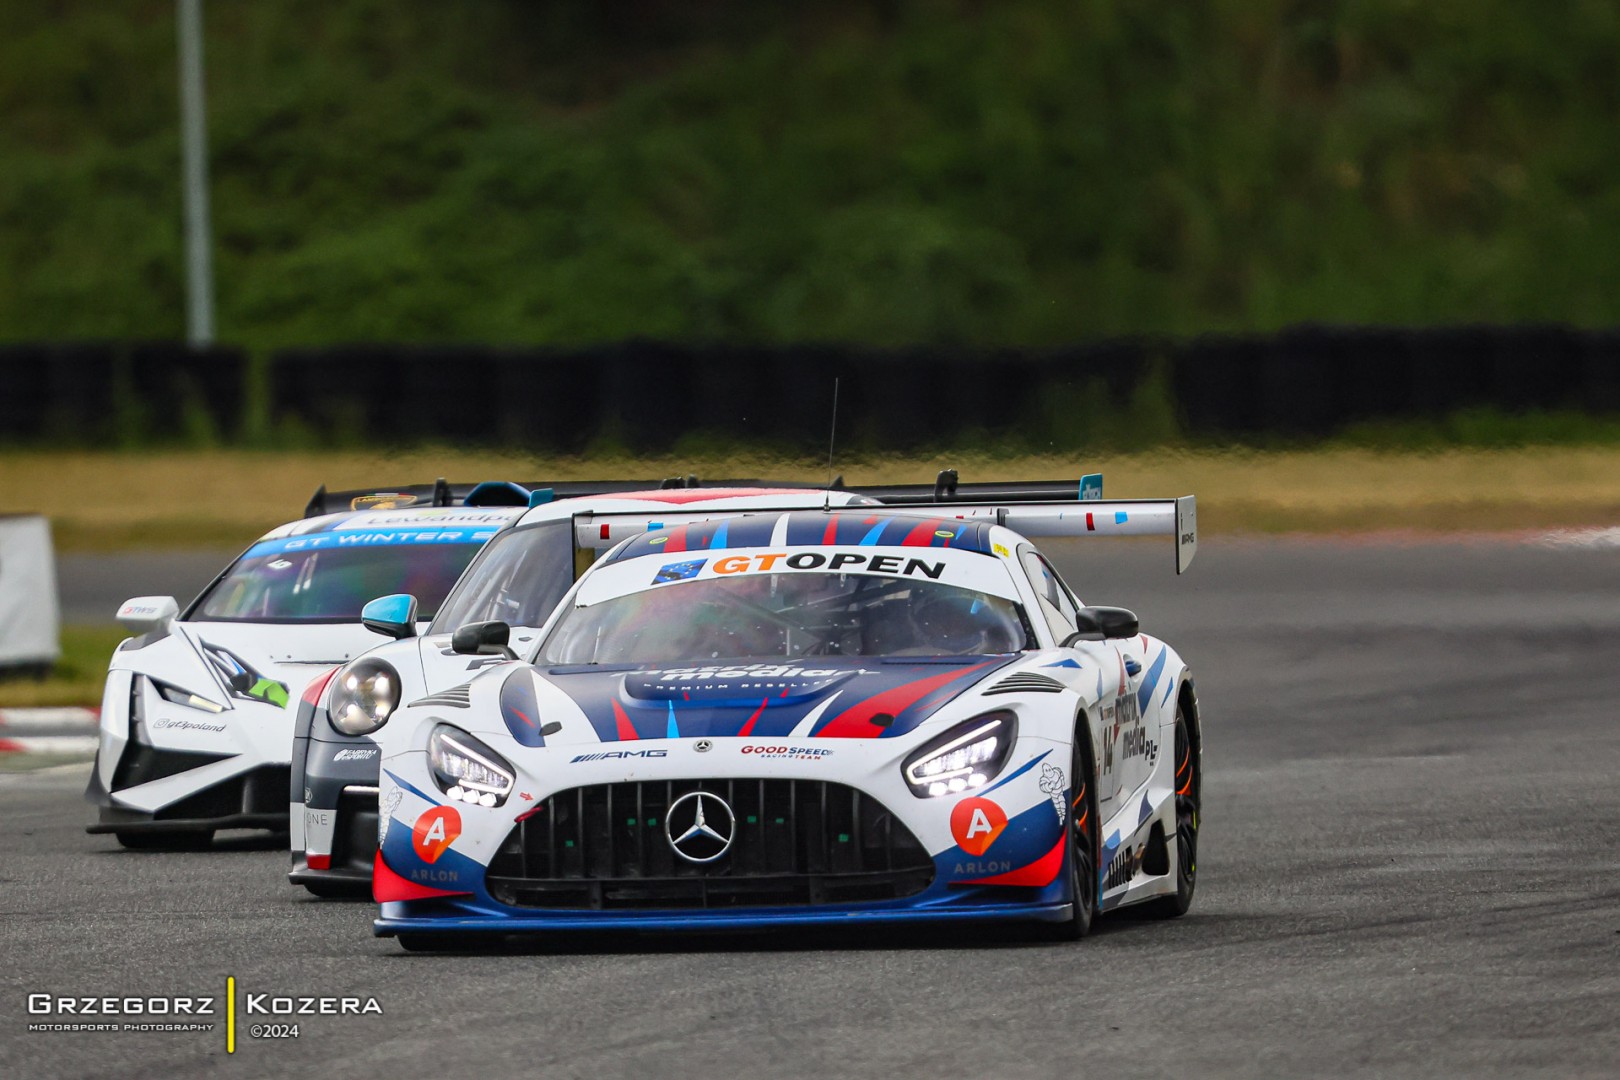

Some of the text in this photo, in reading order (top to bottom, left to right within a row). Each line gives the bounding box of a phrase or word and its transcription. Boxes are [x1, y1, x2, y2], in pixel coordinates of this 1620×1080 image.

[284, 536, 330, 549] GT
[339, 531, 463, 544] WINTER
[660, 667, 838, 681] media
[166, 720, 227, 732] gt3poland
[601, 749, 668, 760] AMG
[1103, 725, 1113, 776] 14
[966, 808, 993, 839] A
[423, 816, 446, 847] A
[953, 861, 1011, 874] ARLON
[411, 869, 458, 882] ARLON
